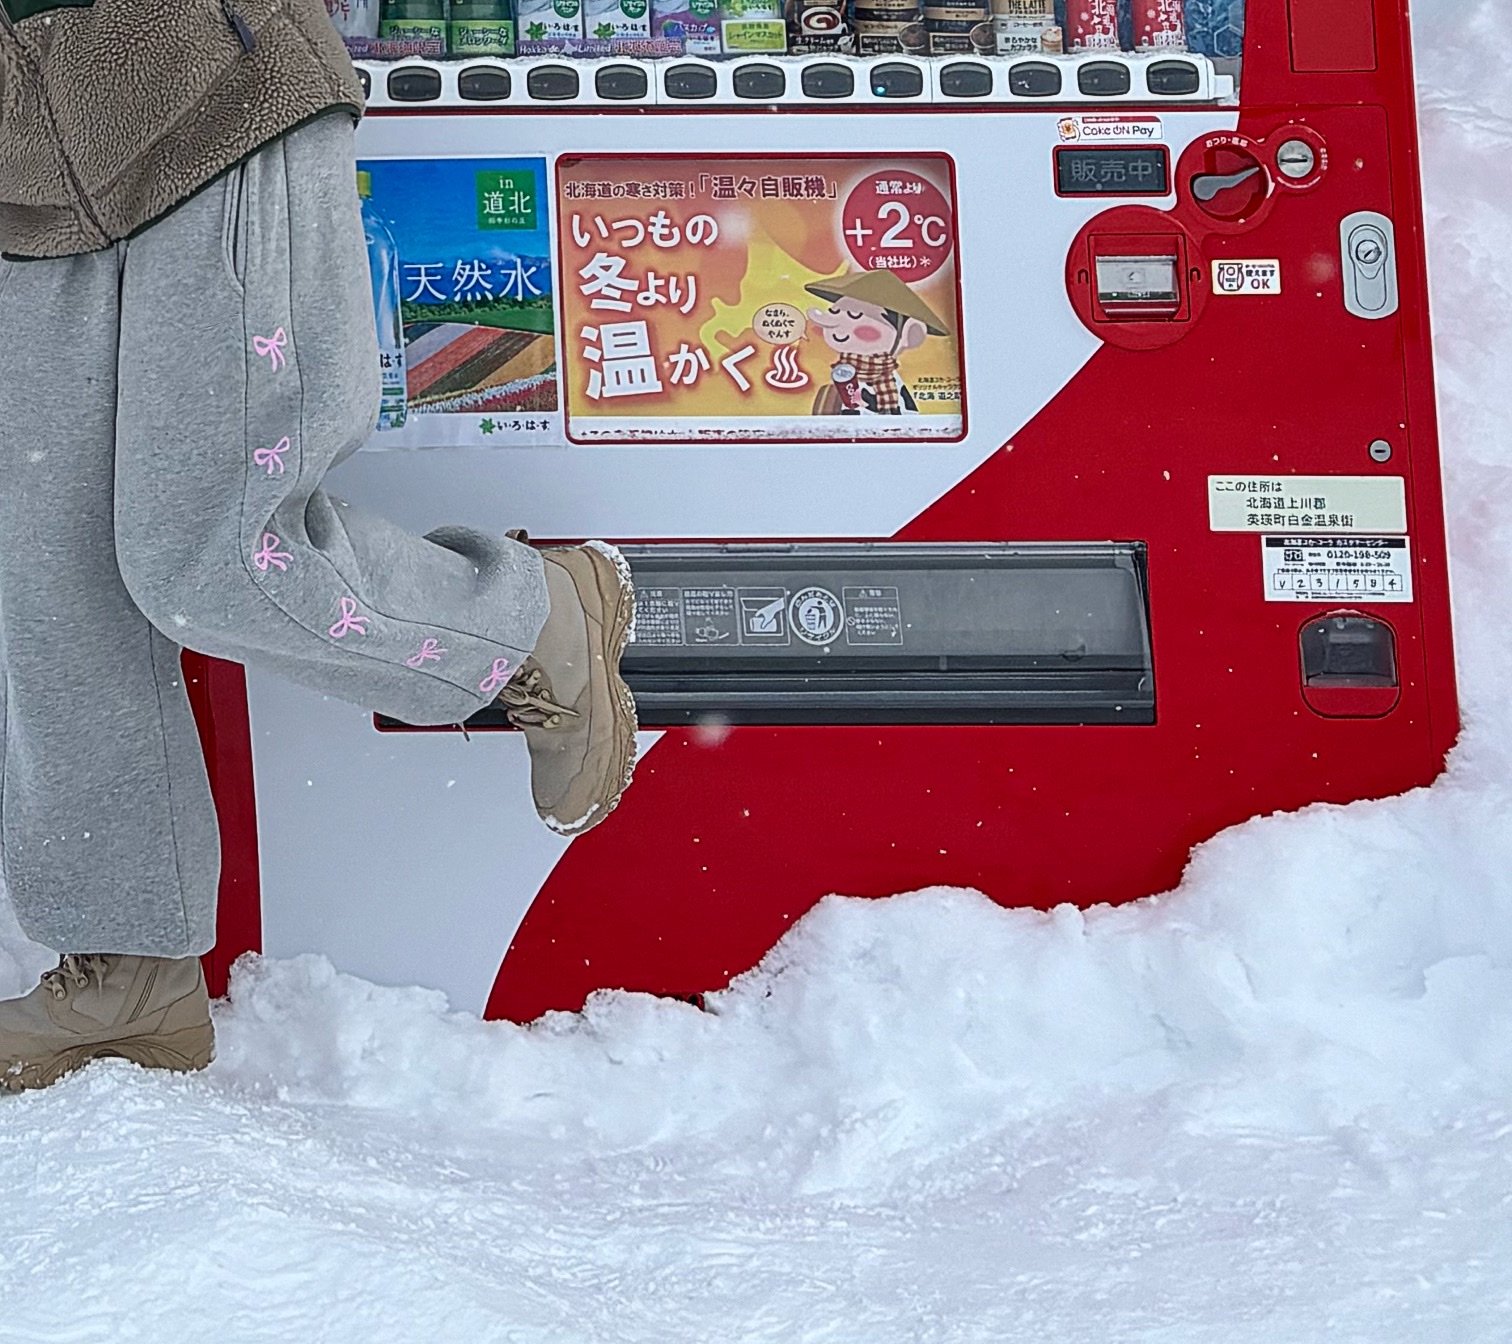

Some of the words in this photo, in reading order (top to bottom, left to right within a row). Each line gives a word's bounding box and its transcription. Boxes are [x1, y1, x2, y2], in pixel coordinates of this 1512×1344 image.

[1008, 0, 1022, 9] THE
[1024, 0, 1046, 9] LATTE
[1082, 126, 1111, 137] Coke
[1132, 125, 1154, 137] Pay
[1071, 160, 1153, 182] 販売中
[499, 176, 514, 189] in
[483, 191, 532, 214] 道北
[572, 210, 719, 249] いつもの
[404, 258, 542, 302] 天然水
[579, 253, 698, 314] 冬より
[1250, 278, 1270, 290] OK
[581, 319, 757, 400] 温かく
[1215, 481, 1283, 493] ここの住所は
[1246, 497, 1326, 510] 北海道上川郡
